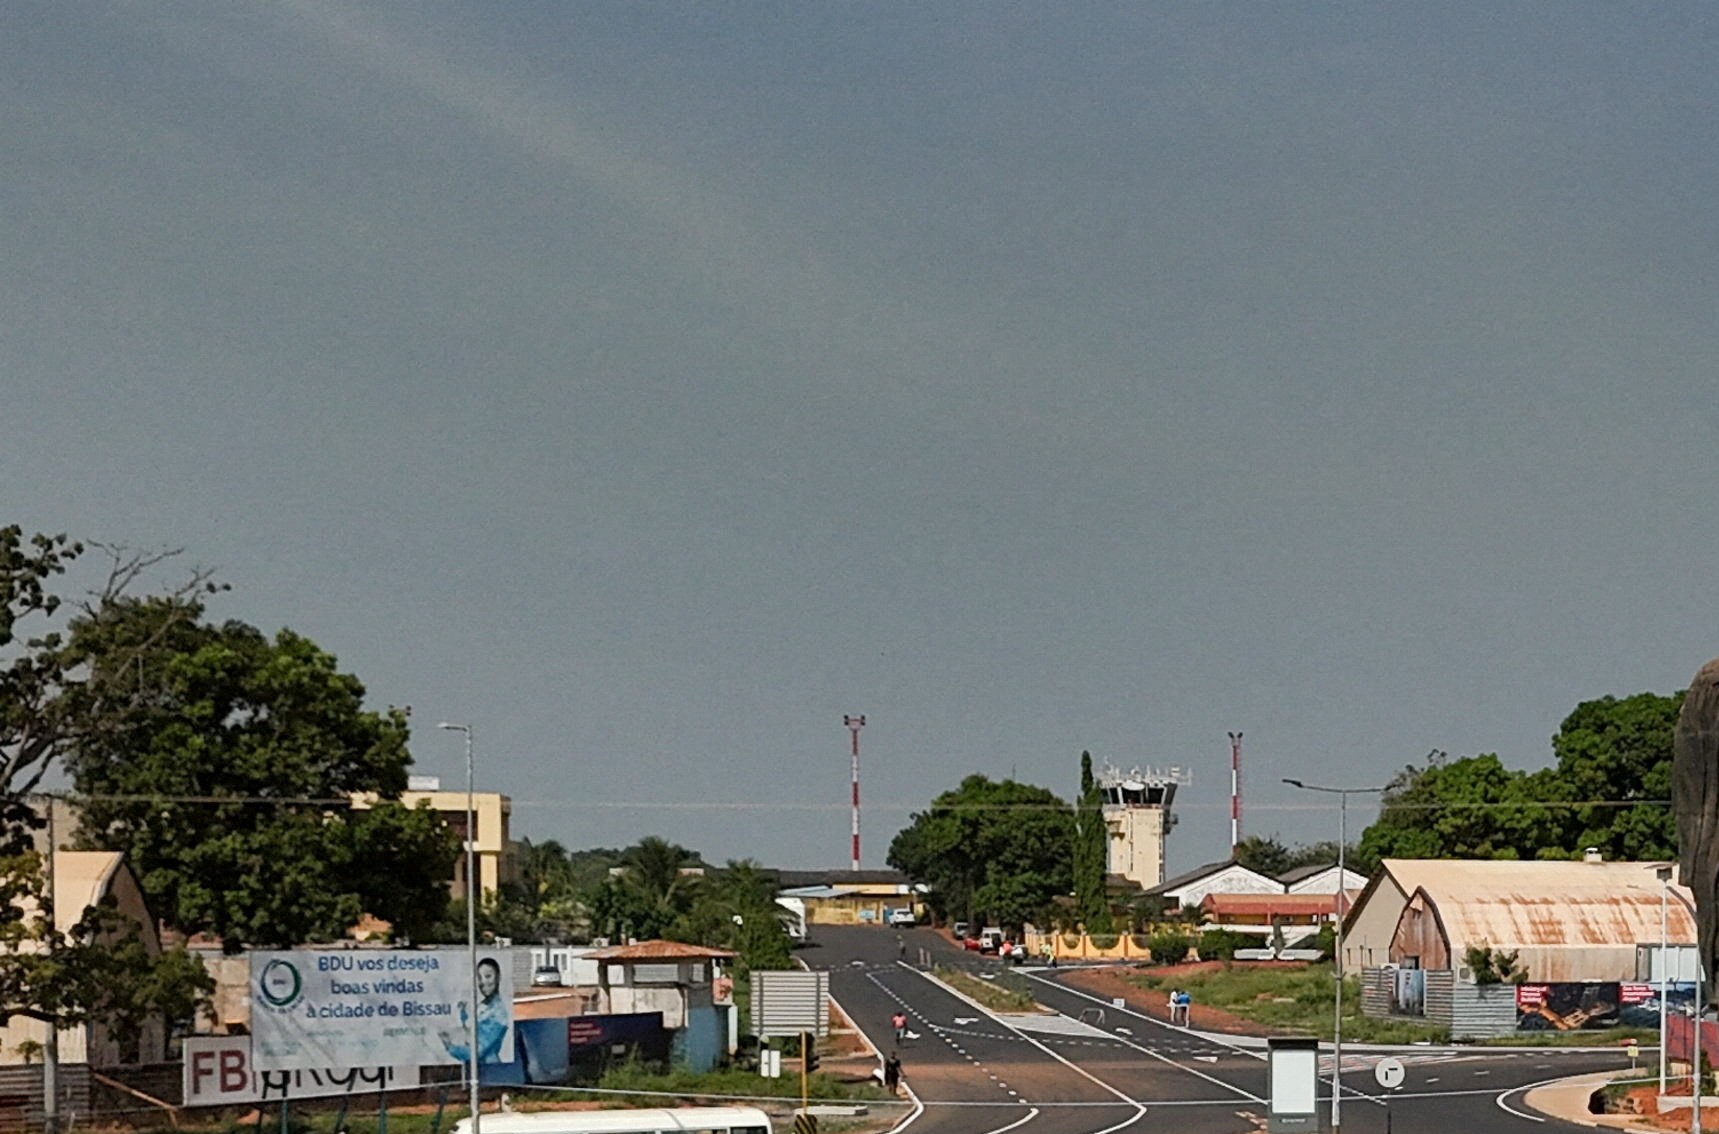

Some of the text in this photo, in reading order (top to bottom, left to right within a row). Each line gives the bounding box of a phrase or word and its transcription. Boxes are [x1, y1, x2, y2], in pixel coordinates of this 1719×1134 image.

[318, 955, 439, 973] BDU vos deseja
[330, 978, 424, 995] boas vindas
[321, 1003, 374, 1018] cidade
[378, 1002, 399, 1017] de
[403, 1000, 452, 1016] Bissau
[193, 1050, 248, 1094] FB
